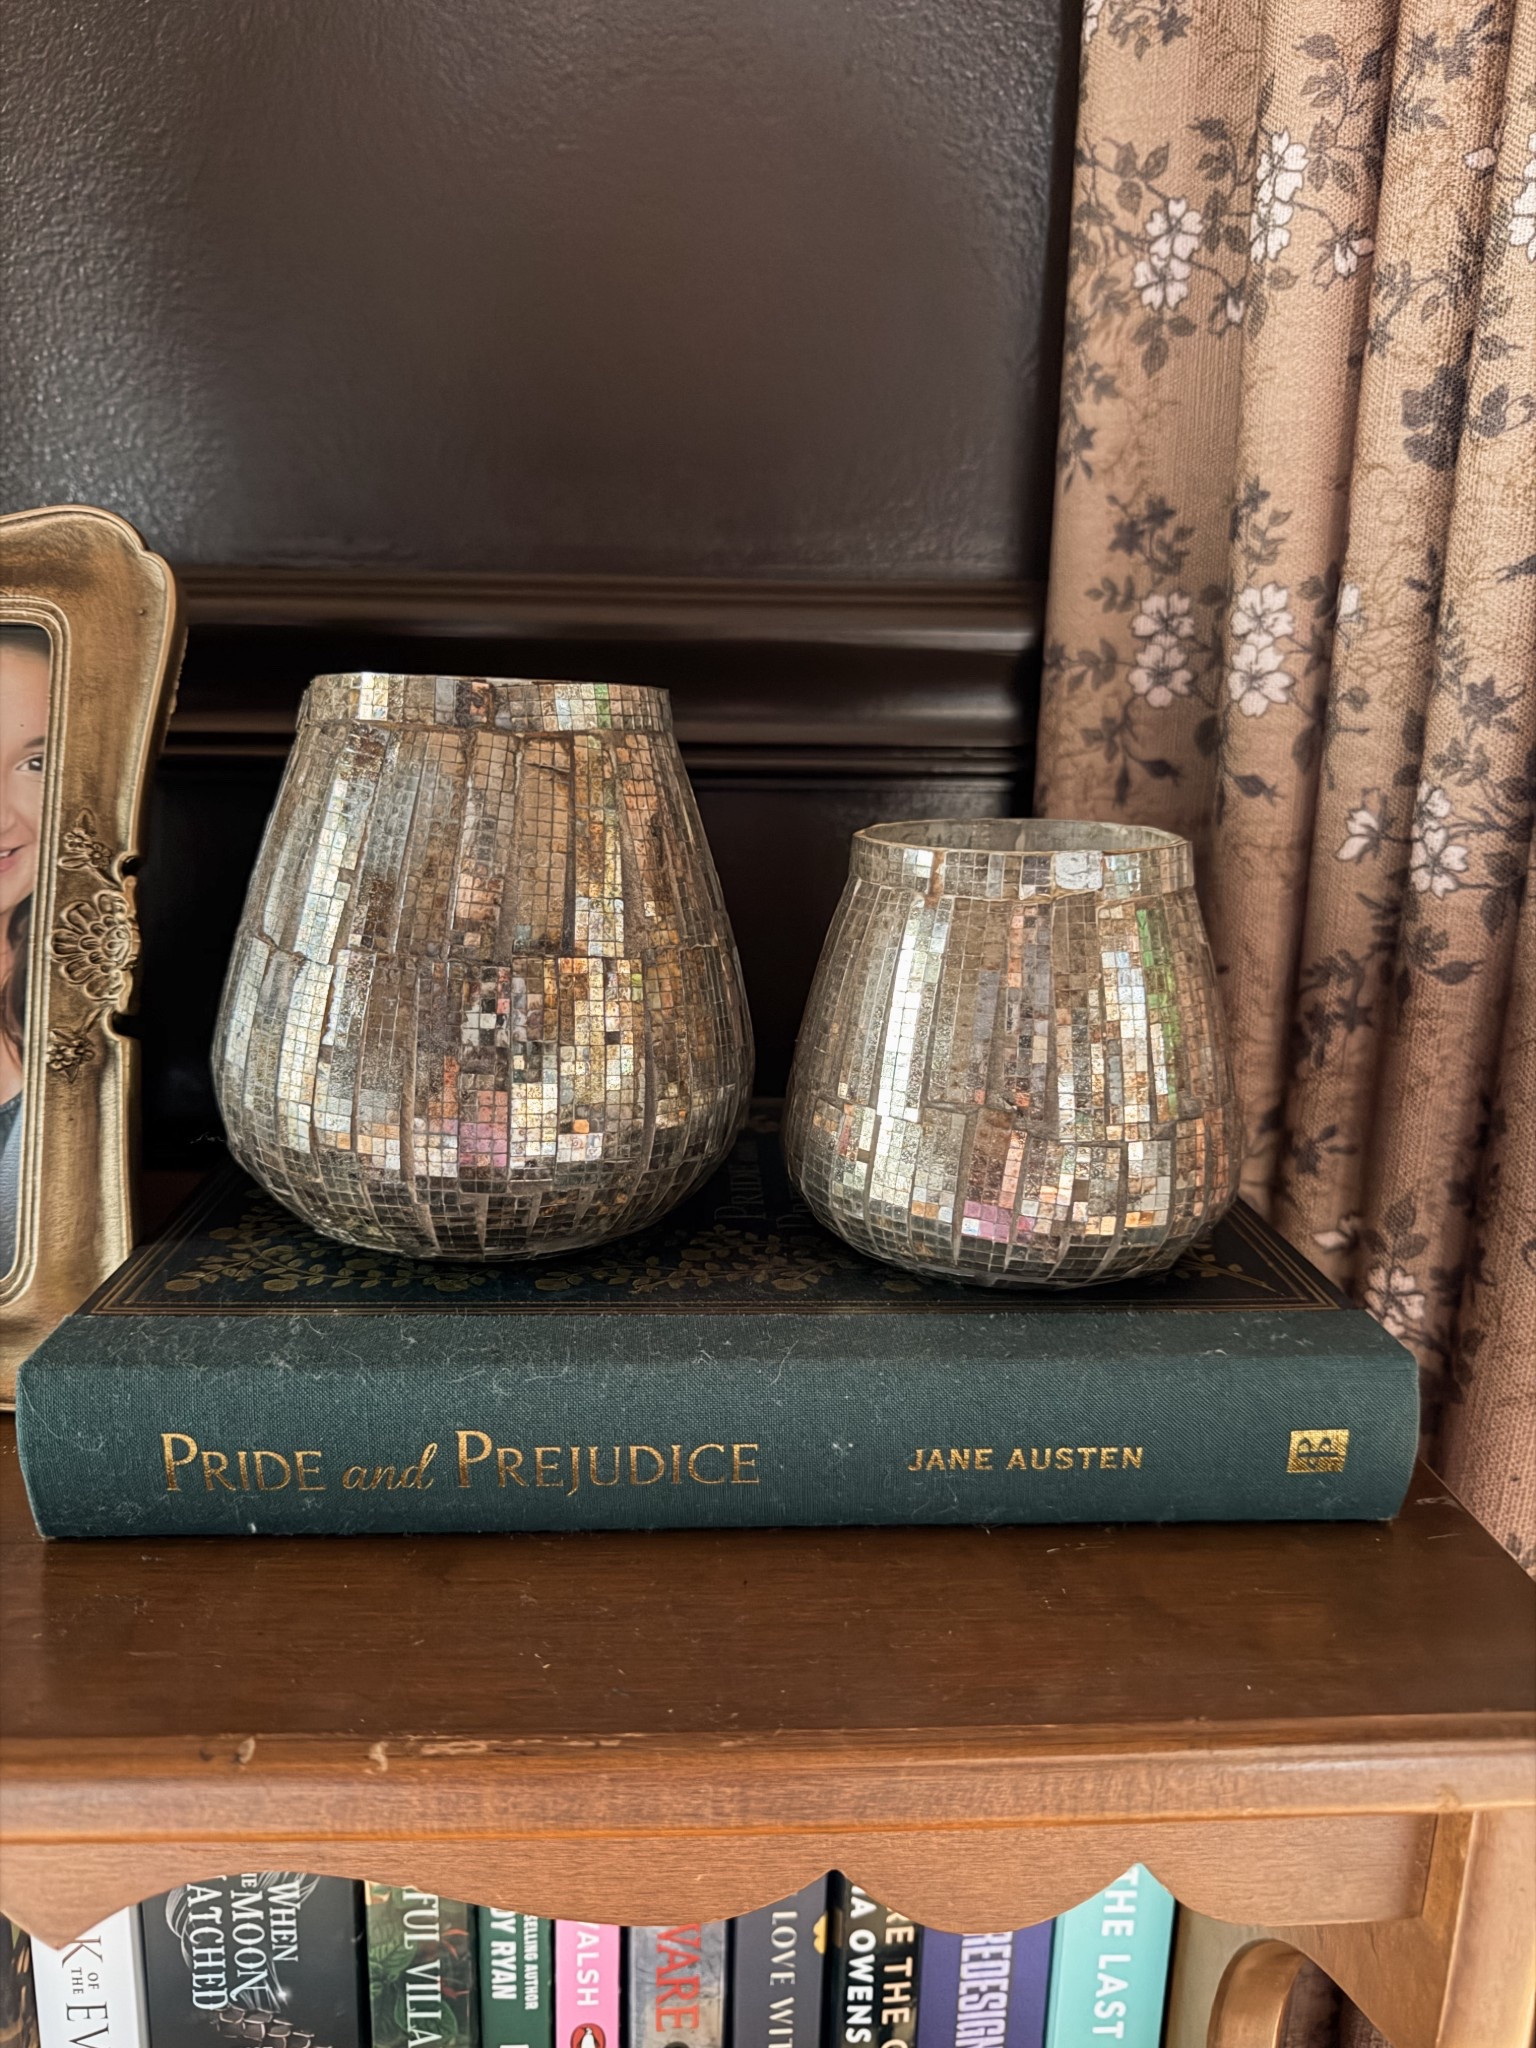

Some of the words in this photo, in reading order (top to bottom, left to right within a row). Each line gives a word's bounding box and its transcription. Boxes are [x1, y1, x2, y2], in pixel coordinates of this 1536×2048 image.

[160, 1432, 326, 1492] PRIDE
[342, 1442, 437, 1492] and
[455, 1430, 760, 1497] PREJUDICE
[907, 1447, 994, 1472] JANE
[1005, 1445, 1145, 1471] AUSTEN
[267, 1880, 302, 1962] WHEN
[402, 1887, 440, 1950] FUL
[1100, 1866, 1140, 1937] THE
[186, 1875, 229, 2011] ATCHED
[229, 1889, 269, 2002] MOON
[491, 1941, 517, 2000] RYAN
[576, 1921, 600, 2006] ALSH
[770, 1911, 798, 1987] LOVE
[71, 1967, 84, 1995] THE
[87, 1972, 100, 1990] OF
[524, 1964, 540, 2011] AUTHOR
[845, 1929, 877, 2044] OWENS
[881, 1956, 914, 2026] THE
[1092, 1954, 1132, 2039] LAST
